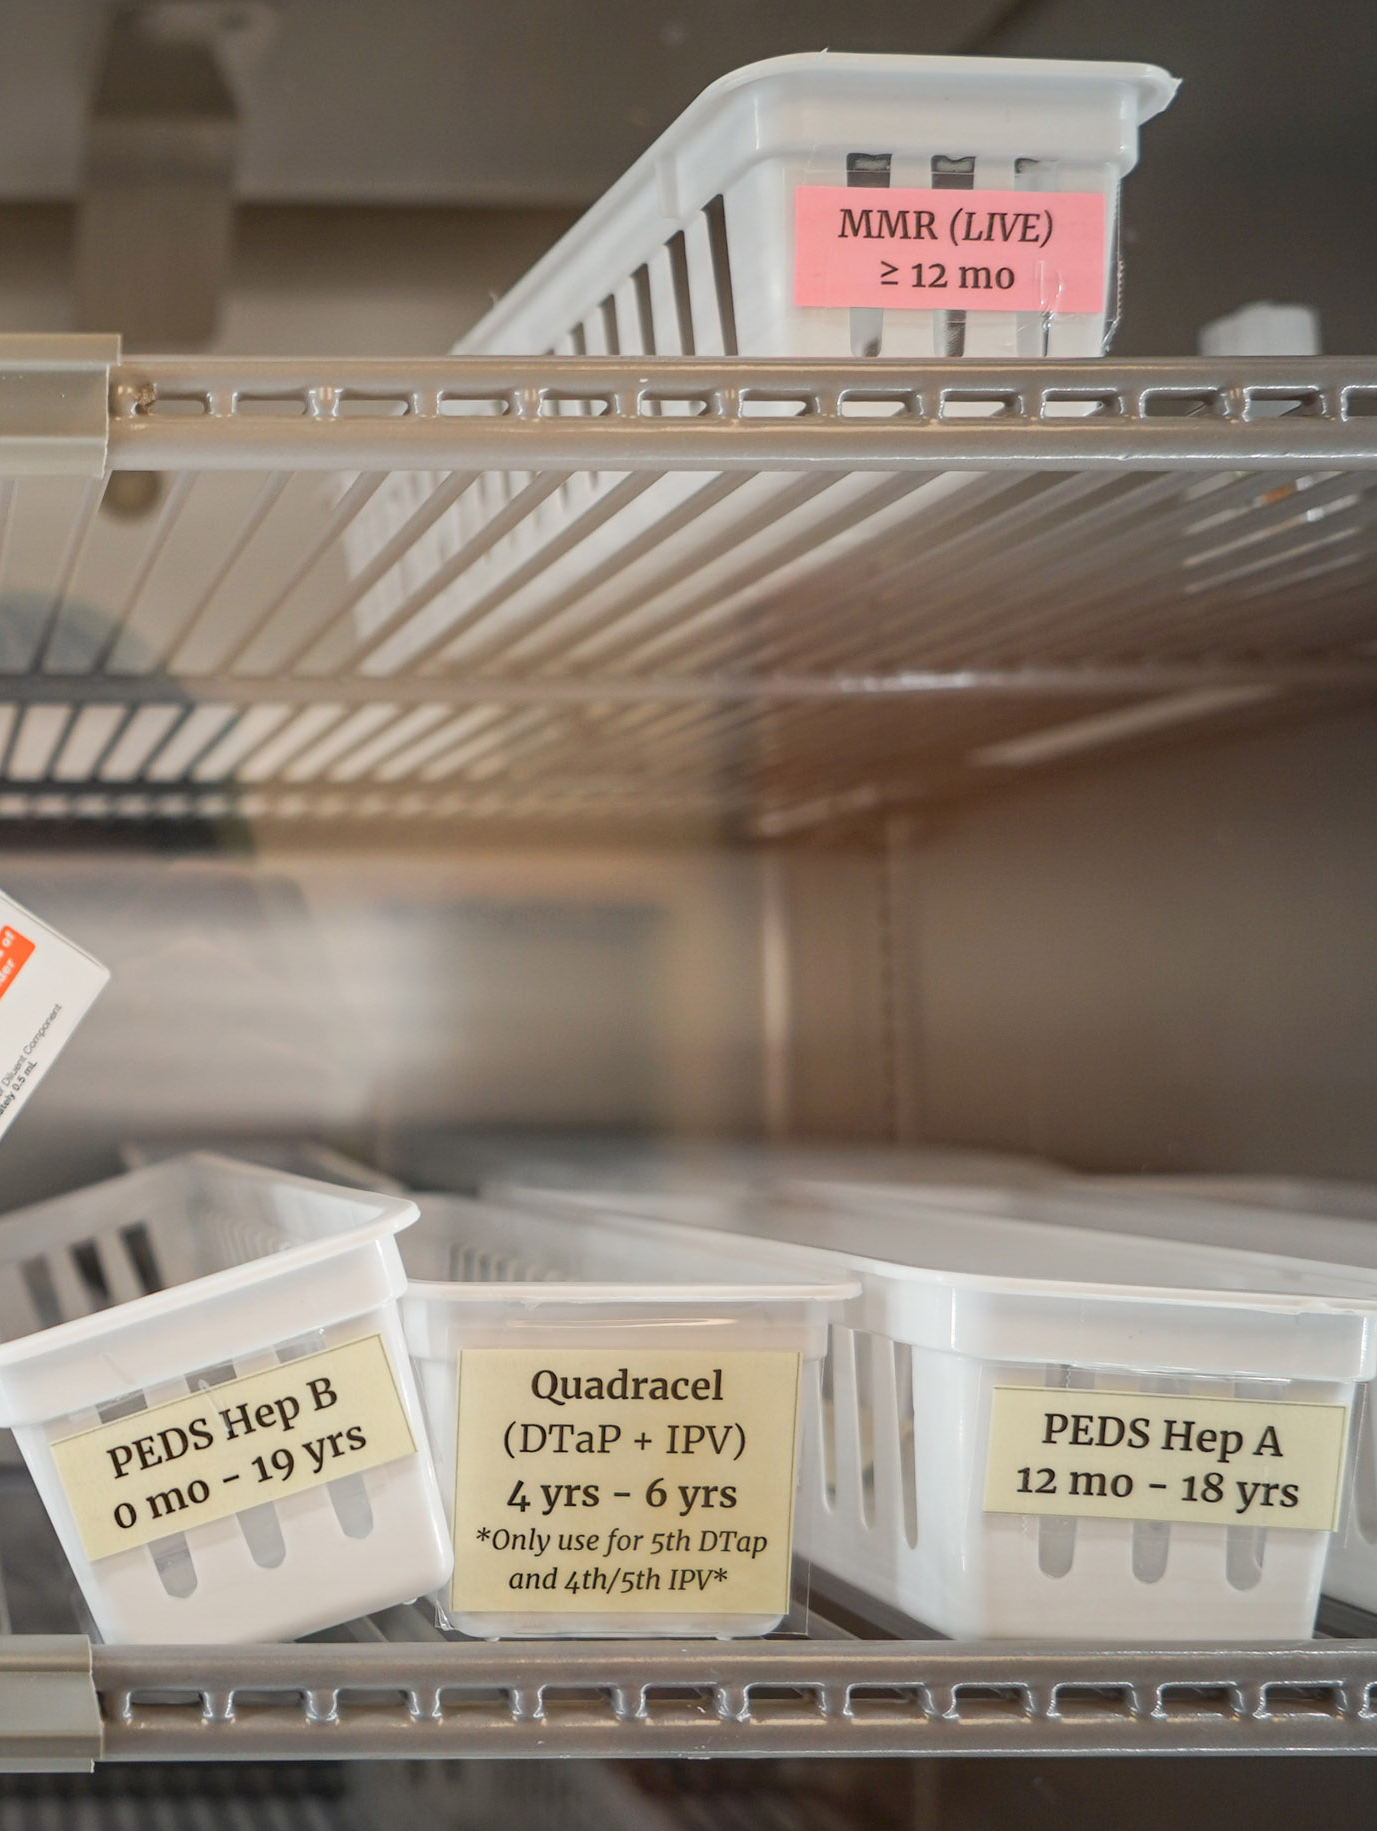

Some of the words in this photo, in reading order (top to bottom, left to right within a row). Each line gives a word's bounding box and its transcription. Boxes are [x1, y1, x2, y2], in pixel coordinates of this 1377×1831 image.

[837, 208, 938, 240] MMR
[949, 207, 1053, 248] (LIVE)
[911, 262, 948, 288] 12
[958, 265, 1015, 290] mo
[0, 929, 15, 948] of
[0, 1053, 28, 1088] Diluent
[21, 1002, 63, 1056] Component
[22, 1060, 38, 1077] mL
[530, 1367, 723, 1406] Quadracel
[105, 1417, 214, 1479] PEDS
[218, 1395, 300, 1440] Hep
[305, 1377, 337, 1411] B
[503, 1420, 621, 1459] (DTaP
[633, 1431, 652, 1450] +
[665, 1422, 745, 1461] IPV)
[1041, 1412, 1150, 1449] PEDS
[1160, 1419, 1243, 1463] Hep
[1251, 1425, 1283, 1457] A
[145, 1479, 210, 1519] mo
[250, 1448, 294, 1483] 19
[301, 1425, 366, 1474] yrs
[1016, 1466, 1057, 1494] 12
[1068, 1471, 1133, 1498] mo
[1180, 1471, 1224, 1503] 18
[1235, 1480, 1299, 1514] yrs
[506, 1479, 530, 1512] 4
[539, 1484, 599, 1516] yrs
[645, 1477, 667, 1508] 6
[677, 1485, 737, 1517] yrs
[557, 1533, 599, 1551] use
[602, 1527, 644, 1557] for
[649, 1528, 690, 1555] 5th
[697, 1530, 767, 1559] DTap
[508, 1566, 557, 1589] and
[563, 1566, 660, 1594] 4th/5th
